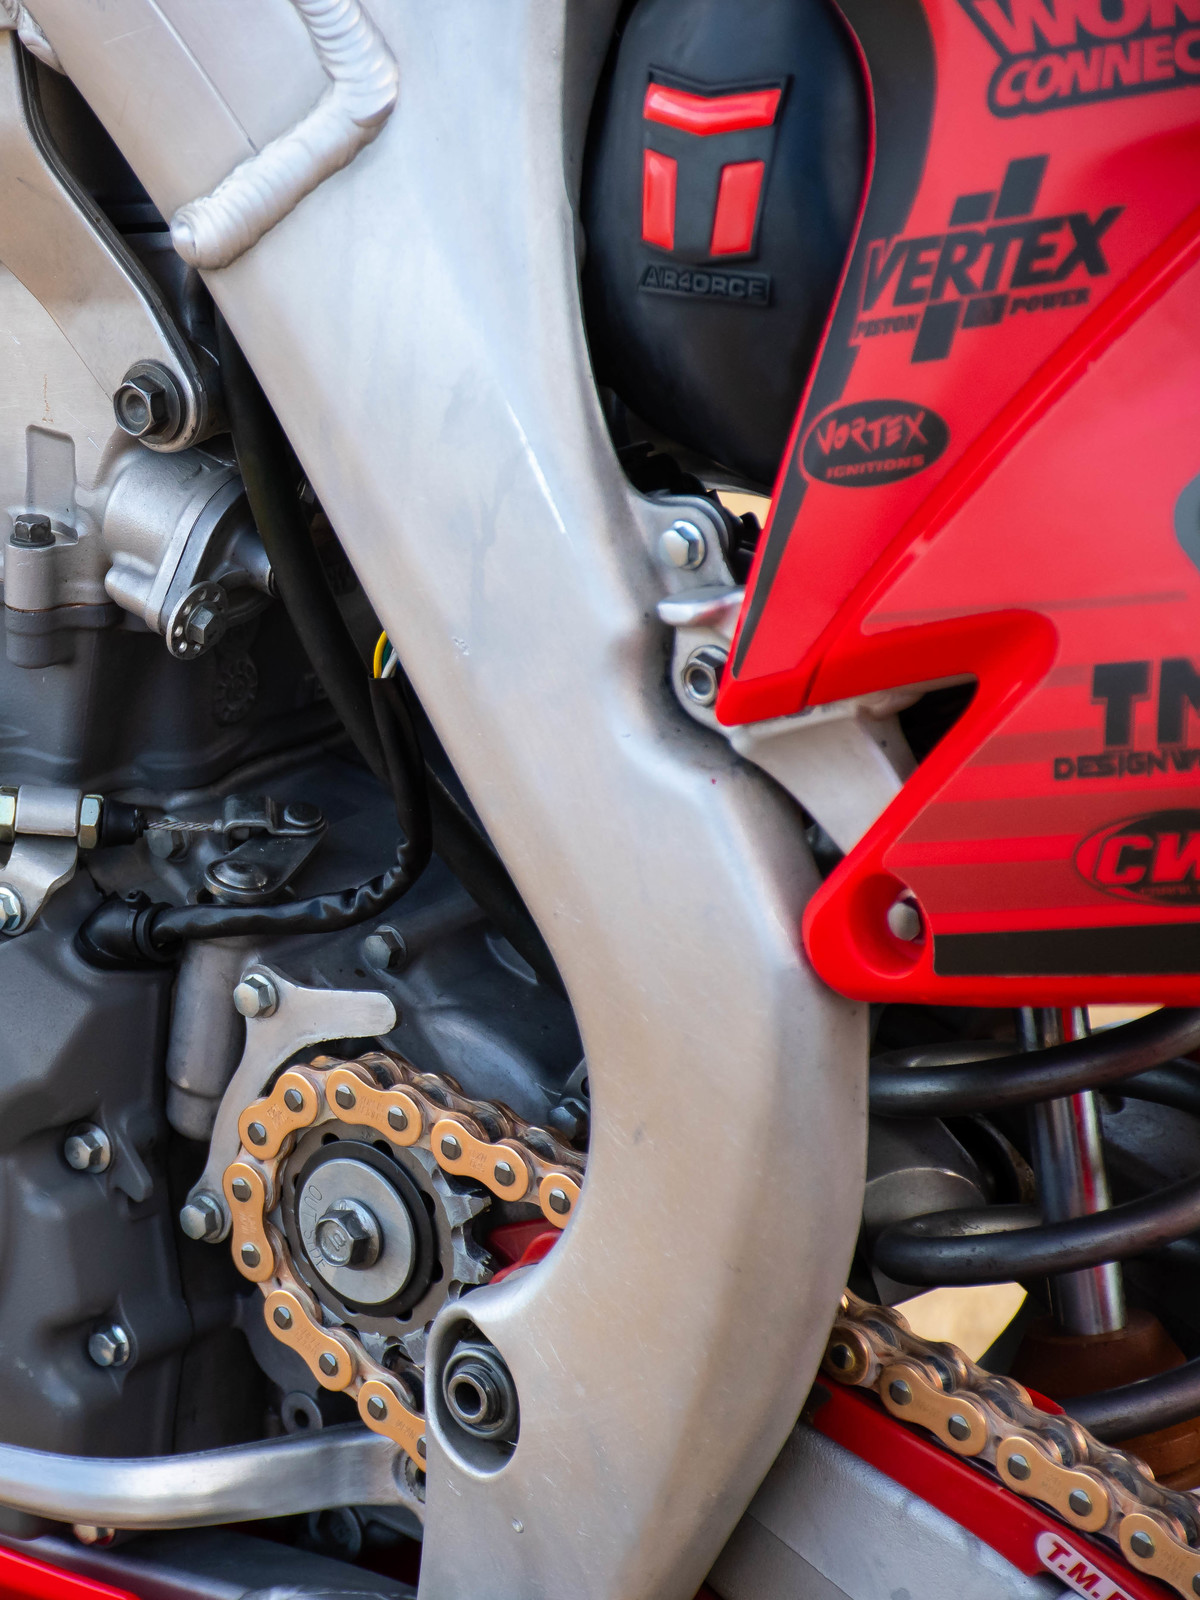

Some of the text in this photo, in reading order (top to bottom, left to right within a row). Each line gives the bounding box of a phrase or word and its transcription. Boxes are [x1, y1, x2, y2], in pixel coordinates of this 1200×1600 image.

[644, 263, 766, 298] AIR4ORCE
[860, 204, 1126, 313] VERTEX
[815, 410, 928, 457] VORTEX
[826, 453, 925, 480] IGNITIONS
[1046, 1540, 1130, 1600] T.M.
